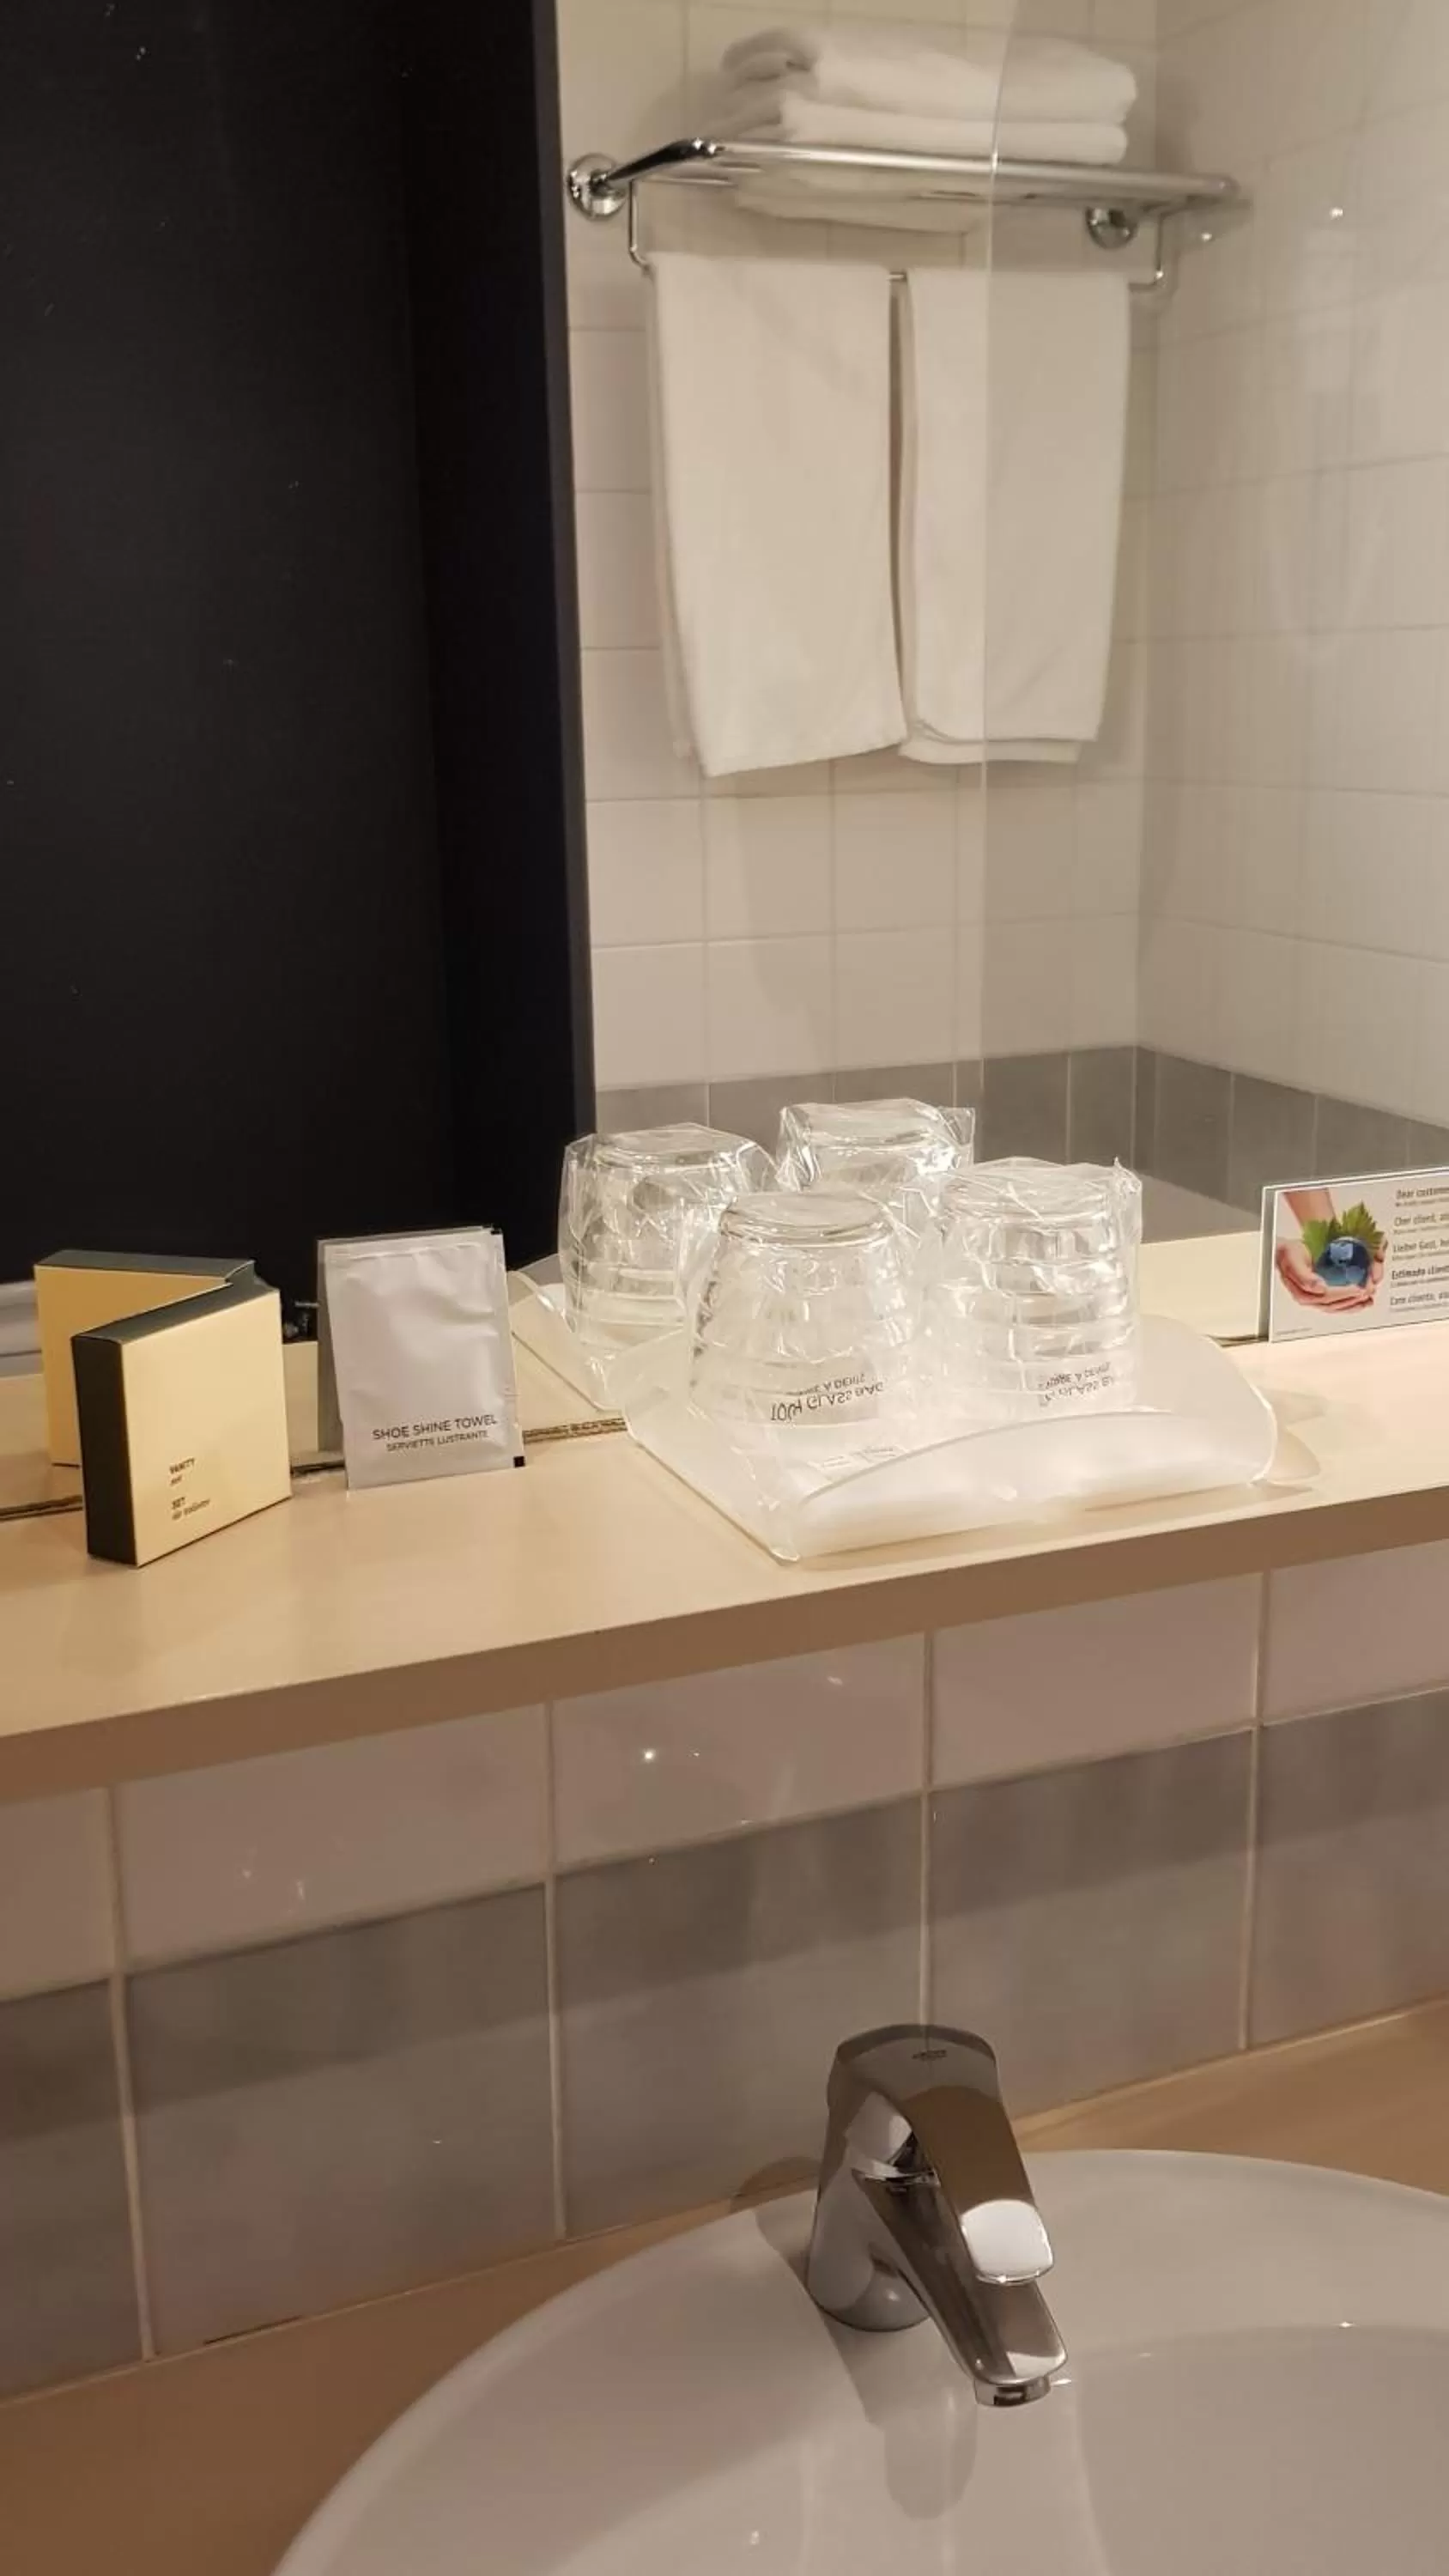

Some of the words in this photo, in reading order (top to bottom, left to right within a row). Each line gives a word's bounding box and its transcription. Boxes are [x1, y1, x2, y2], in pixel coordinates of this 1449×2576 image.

[373, 1425, 409, 1440] SHOE
[412, 1419, 452, 1436] SHINE
[454, 1414, 498, 1430] TOWEL
[386, 1437, 434, 1451] SERVIETTE
[437, 1430, 488, 1445] LUSTRANTE
